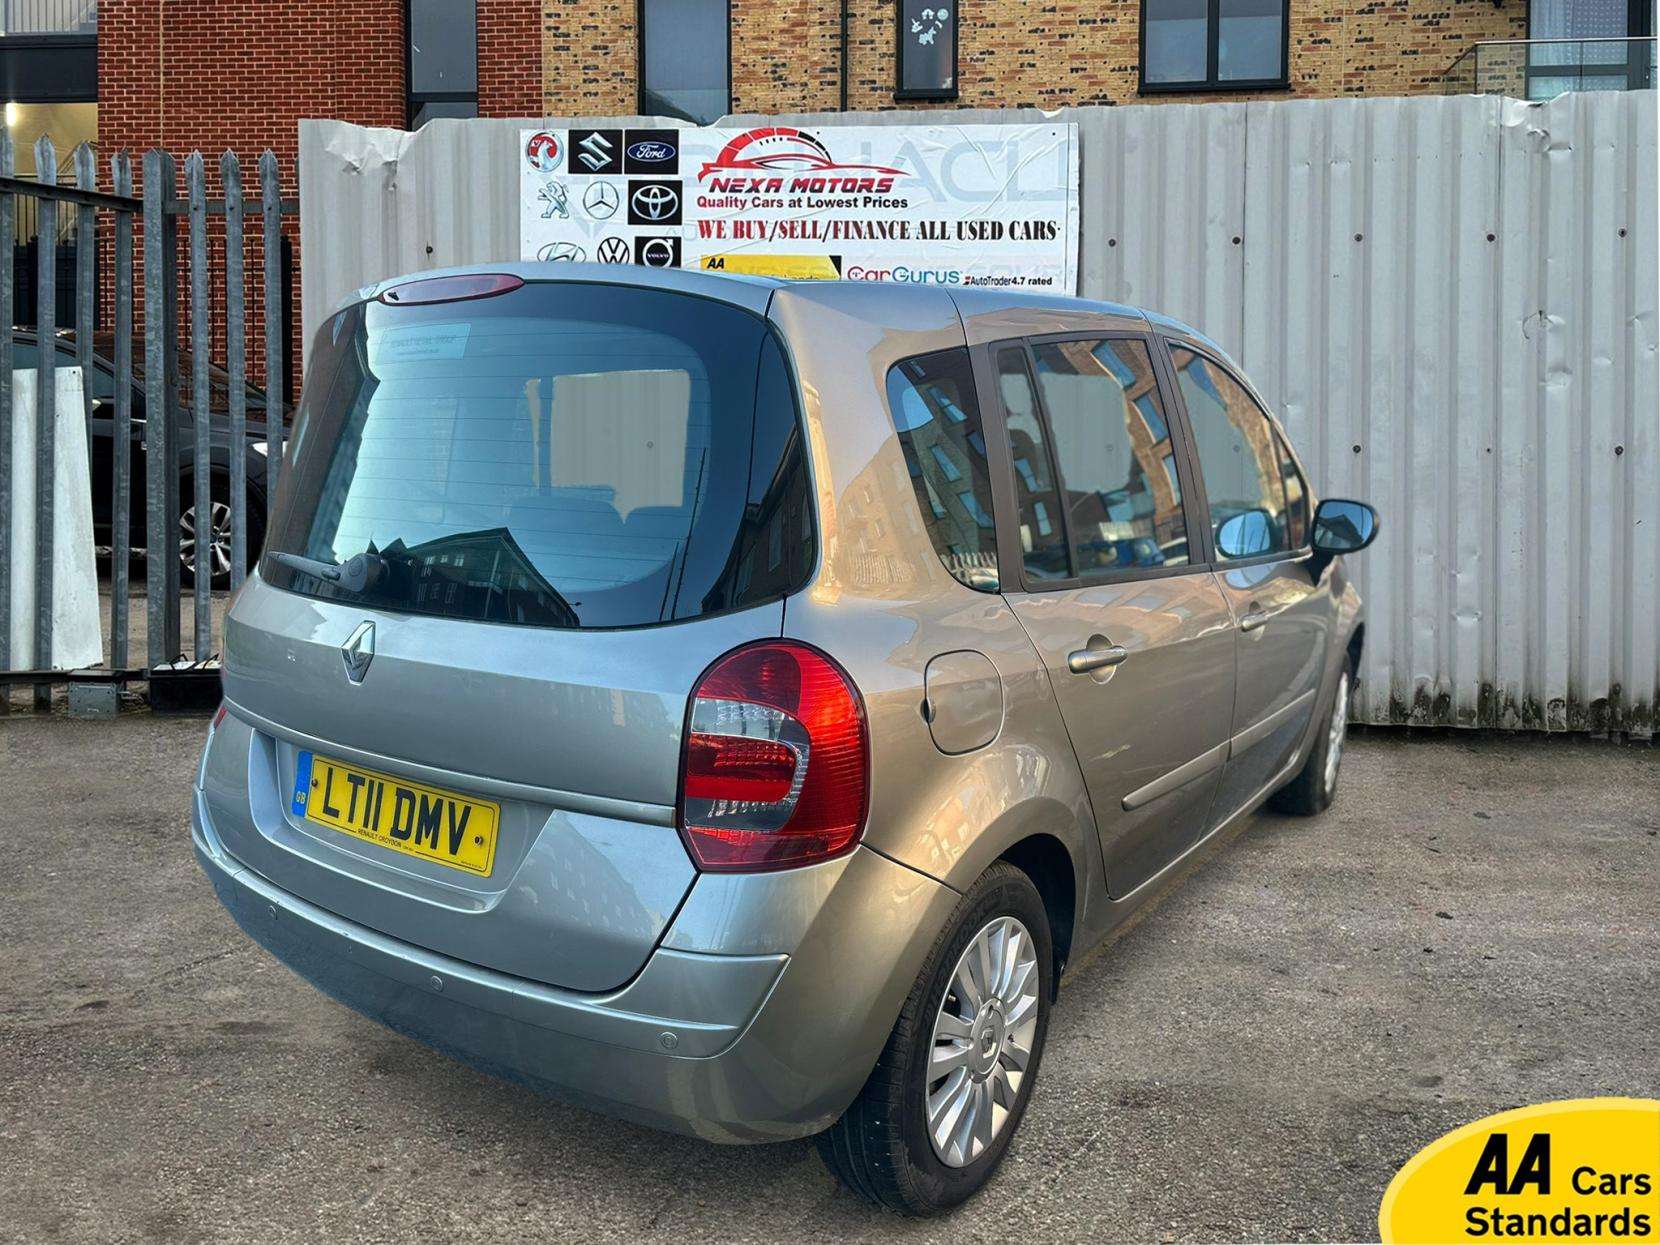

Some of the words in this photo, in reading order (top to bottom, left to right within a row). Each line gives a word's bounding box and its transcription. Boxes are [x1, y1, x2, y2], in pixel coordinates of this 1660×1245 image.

[636, 144, 666, 158] Ford
[708, 178, 784, 193] NEXA
[789, 178, 894, 193] MOTORS
[697, 195, 747, 210] Quality
[752, 196, 784, 208] Cars
[788, 196, 802, 208] at
[807, 196, 858, 208] Lowest
[863, 196, 908, 208] Prices
[697, 220, 726, 239] WE
[916, 220, 951, 240] ALL
[956, 220, 1004, 240] USED
[1008, 220, 1057, 240] CARS
[706, 258, 725, 269] AA
[847, 266, 960, 284] CarGurus
[1027, 275, 1053, 286] rated
[390, 786, 472, 856] DMV
